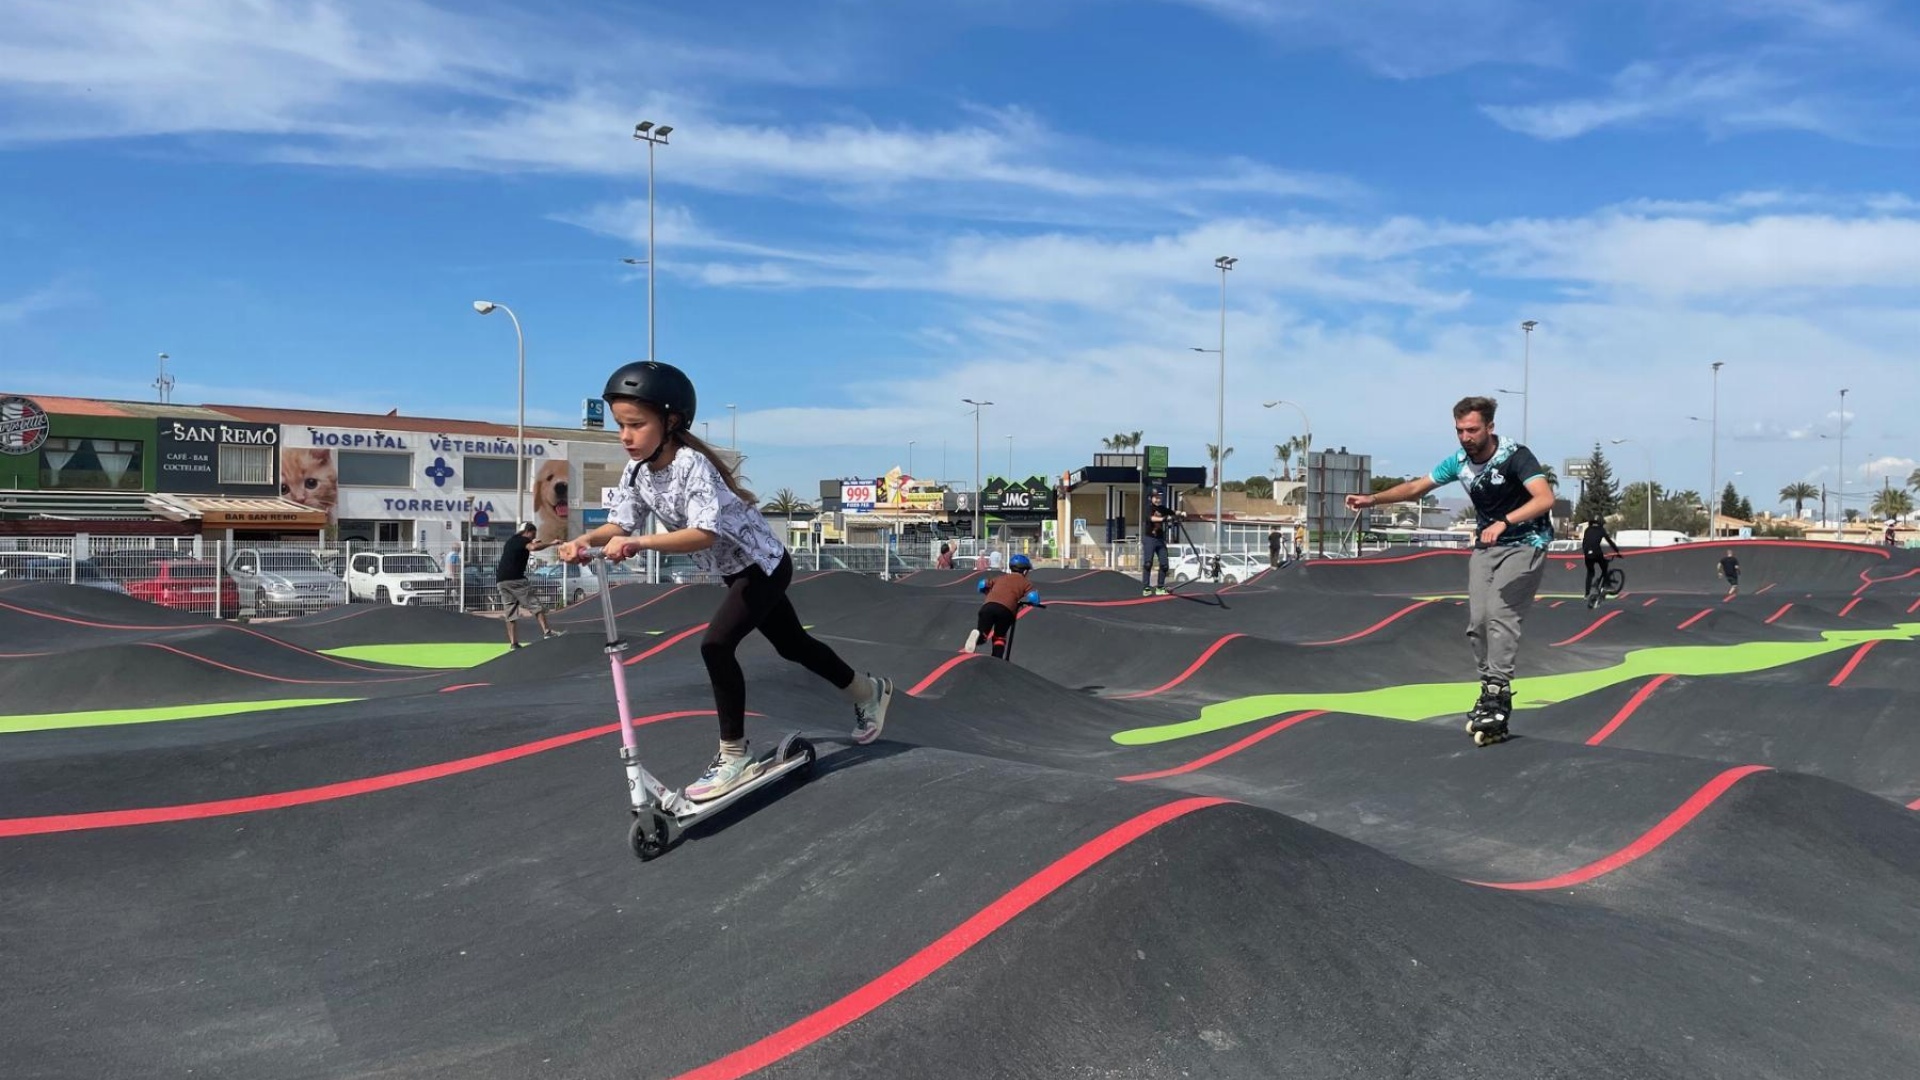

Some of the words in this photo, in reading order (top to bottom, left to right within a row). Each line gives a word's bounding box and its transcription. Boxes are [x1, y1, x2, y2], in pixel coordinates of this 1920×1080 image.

[174, 426, 216, 442] SAN
[220, 428, 278, 445] REMO
[310, 431, 407, 449] HOSPITAL
[166, 453, 187, 461] CAFÉ
[163, 463, 212, 472] COCTELERÍA
[847, 487, 870, 501] 999
[1002, 492, 1030, 507] JMG
[383, 498, 495, 513] TORREVIEJA
[224, 513, 245, 521] BAR
[247, 513, 268, 521] SAN
[270, 513, 298, 521] REMO
